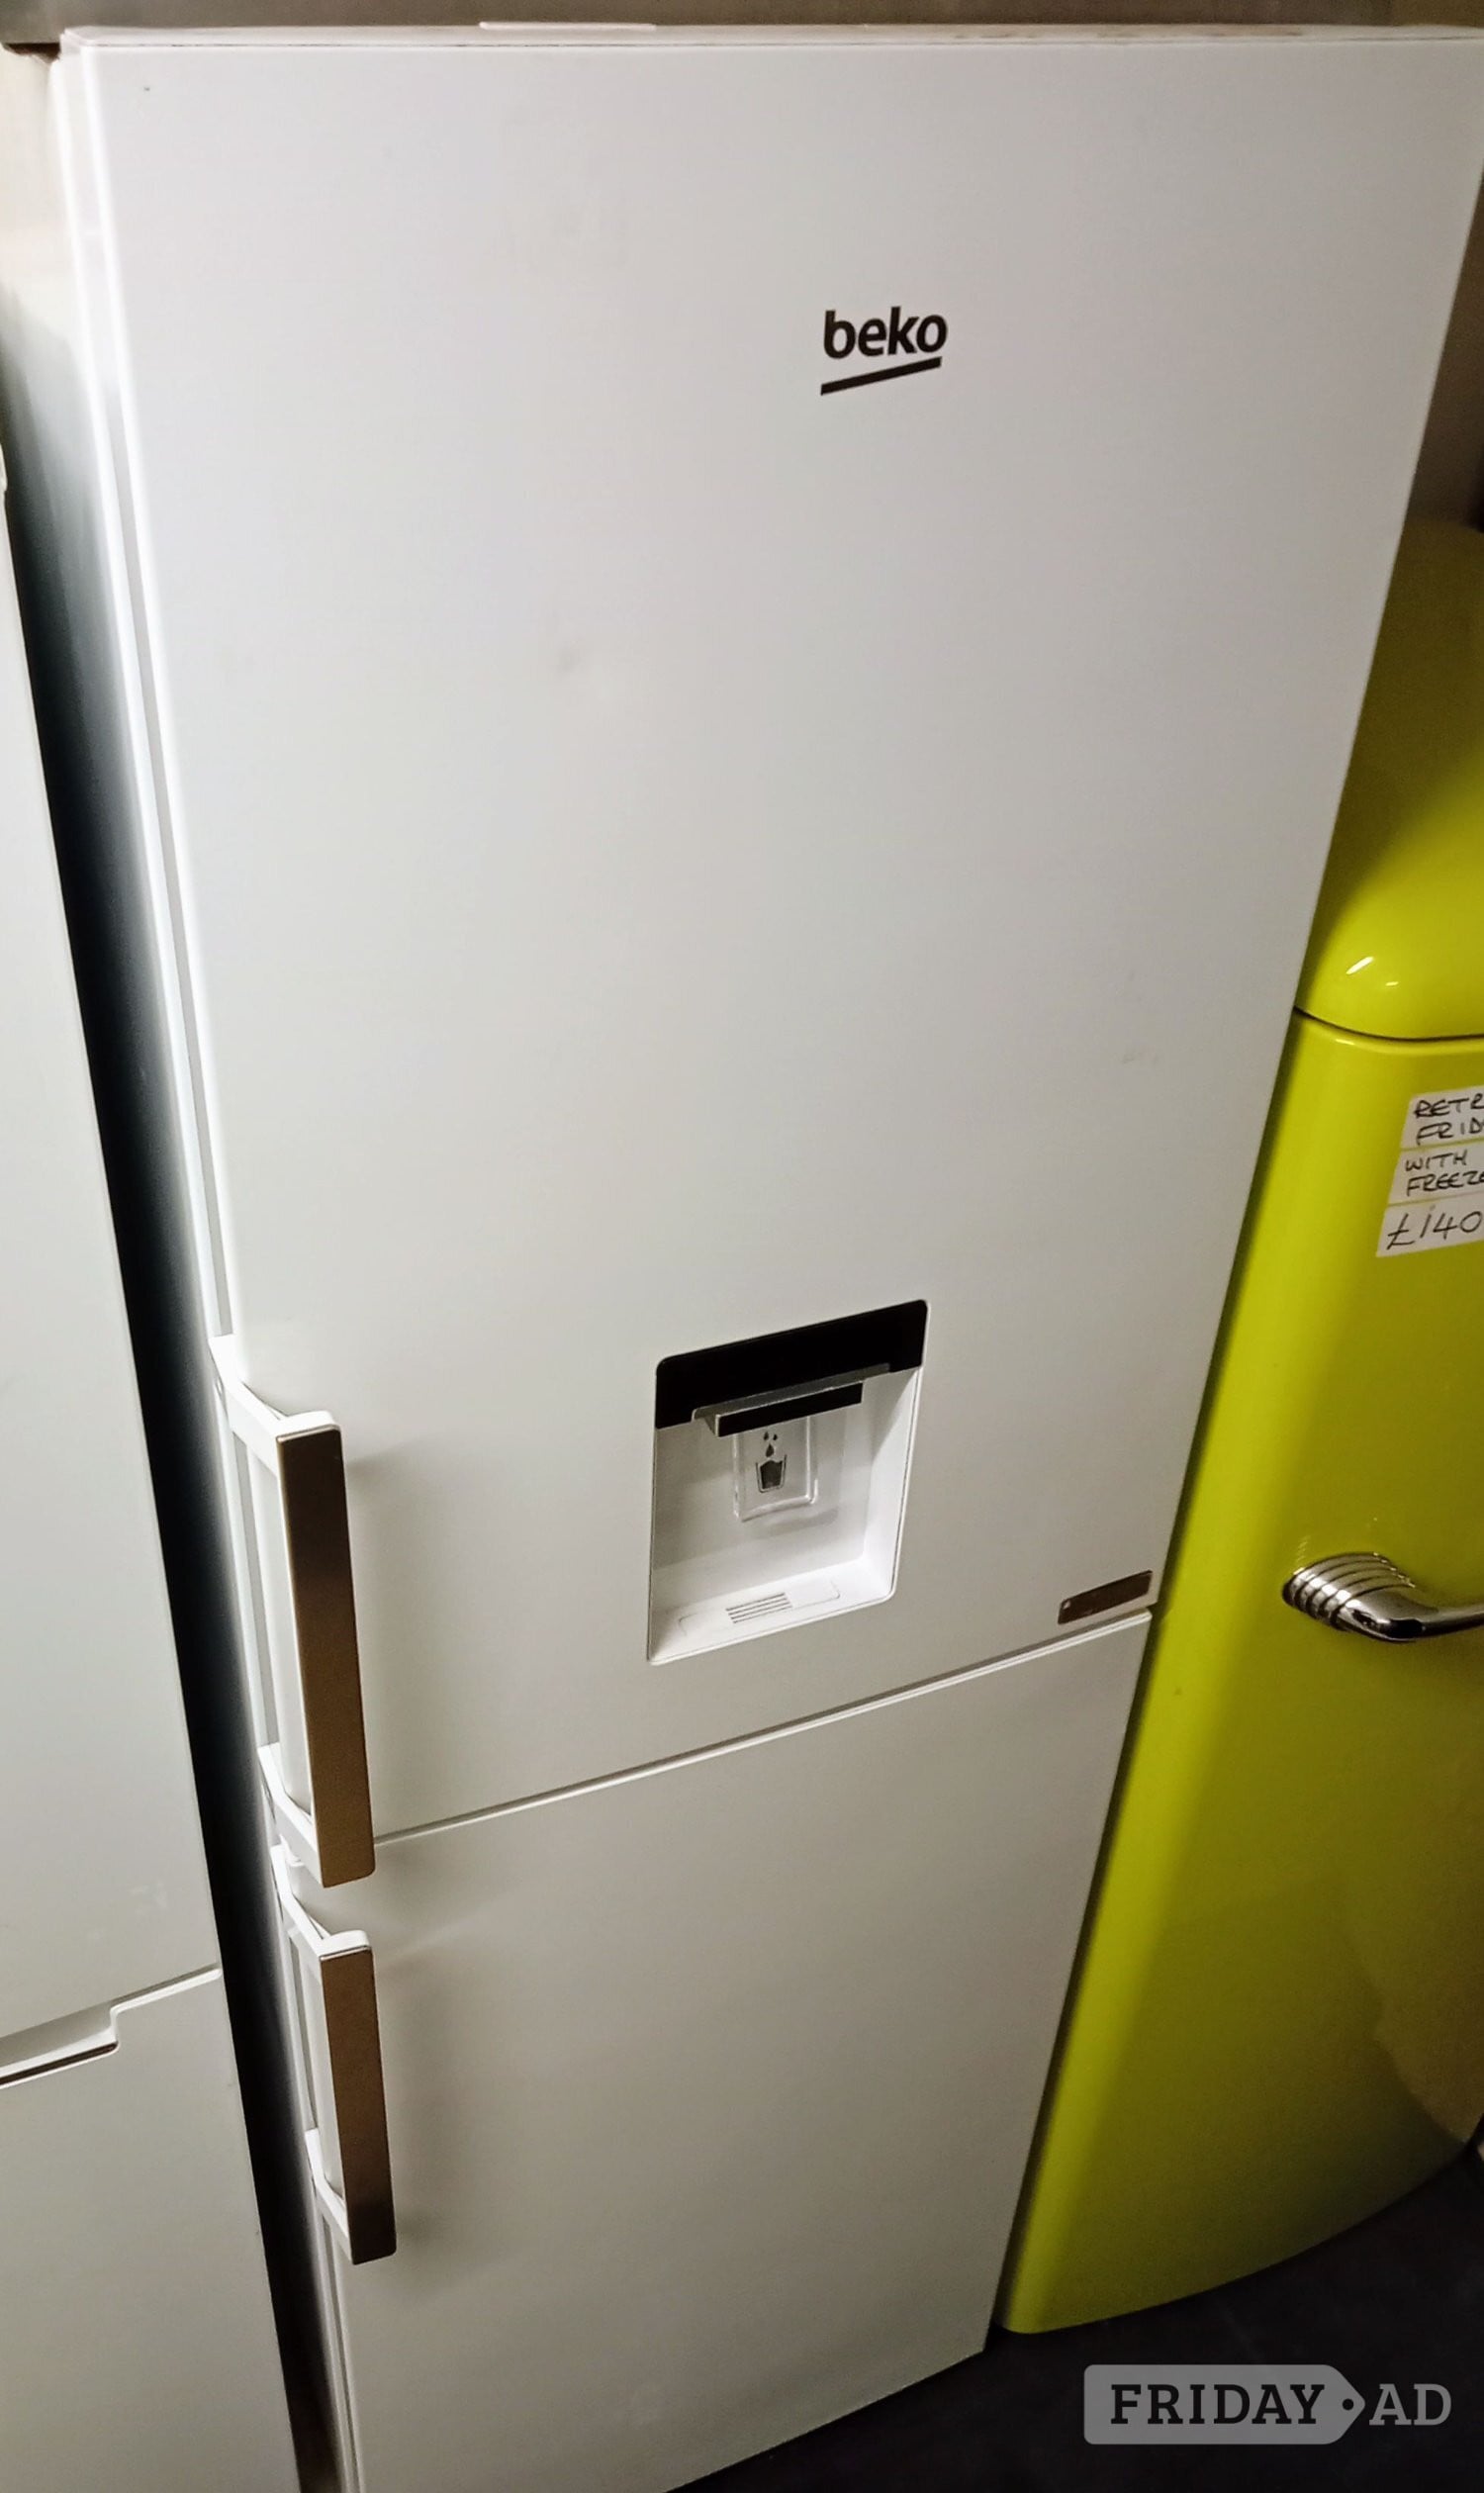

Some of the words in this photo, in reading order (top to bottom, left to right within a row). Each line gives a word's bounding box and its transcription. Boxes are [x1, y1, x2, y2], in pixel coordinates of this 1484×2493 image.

[823, 306, 948, 360] beko
[1416, 1117, 1484, 1146] FRID
[1405, 1149, 1468, 1172] WITH
[1386, 1210, 1483, 1250] £140
